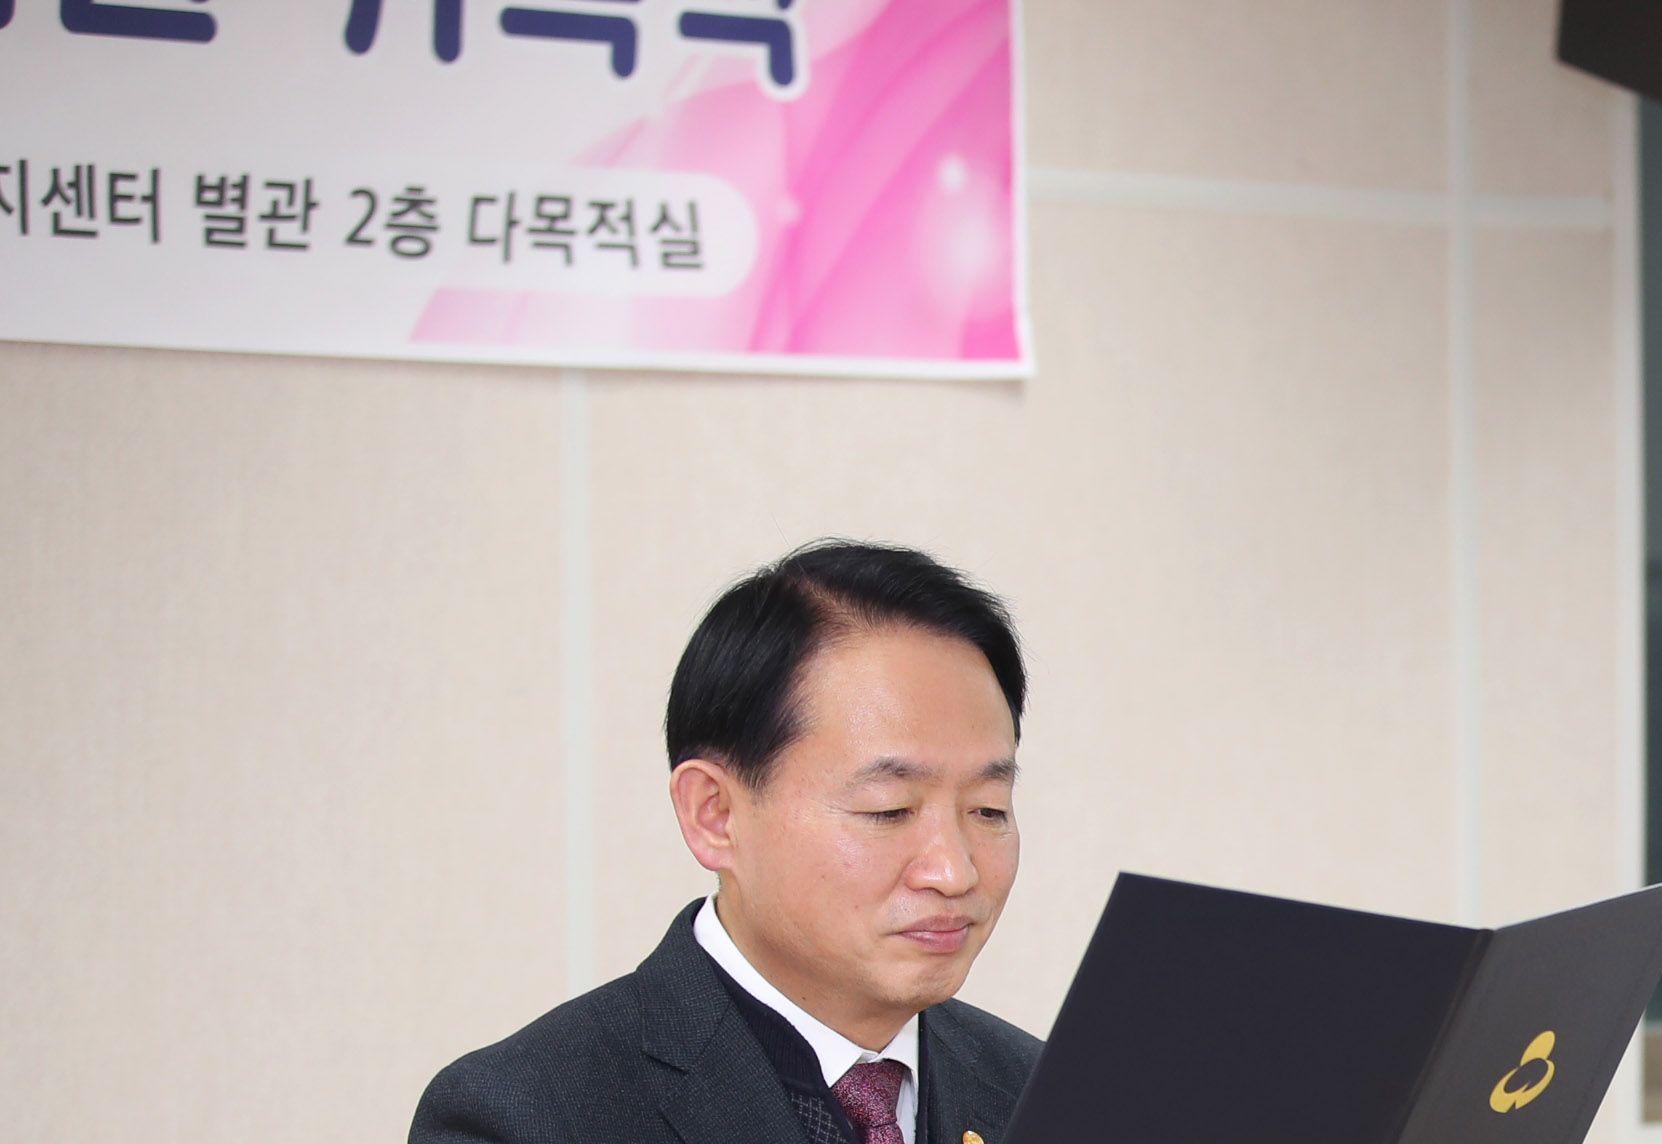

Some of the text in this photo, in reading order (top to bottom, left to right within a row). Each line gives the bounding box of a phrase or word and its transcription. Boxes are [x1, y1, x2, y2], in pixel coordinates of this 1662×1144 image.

[194, 174, 319, 250] 별관
[344, 187, 440, 258] 2층
[467, 192, 704, 269] 다목적실
